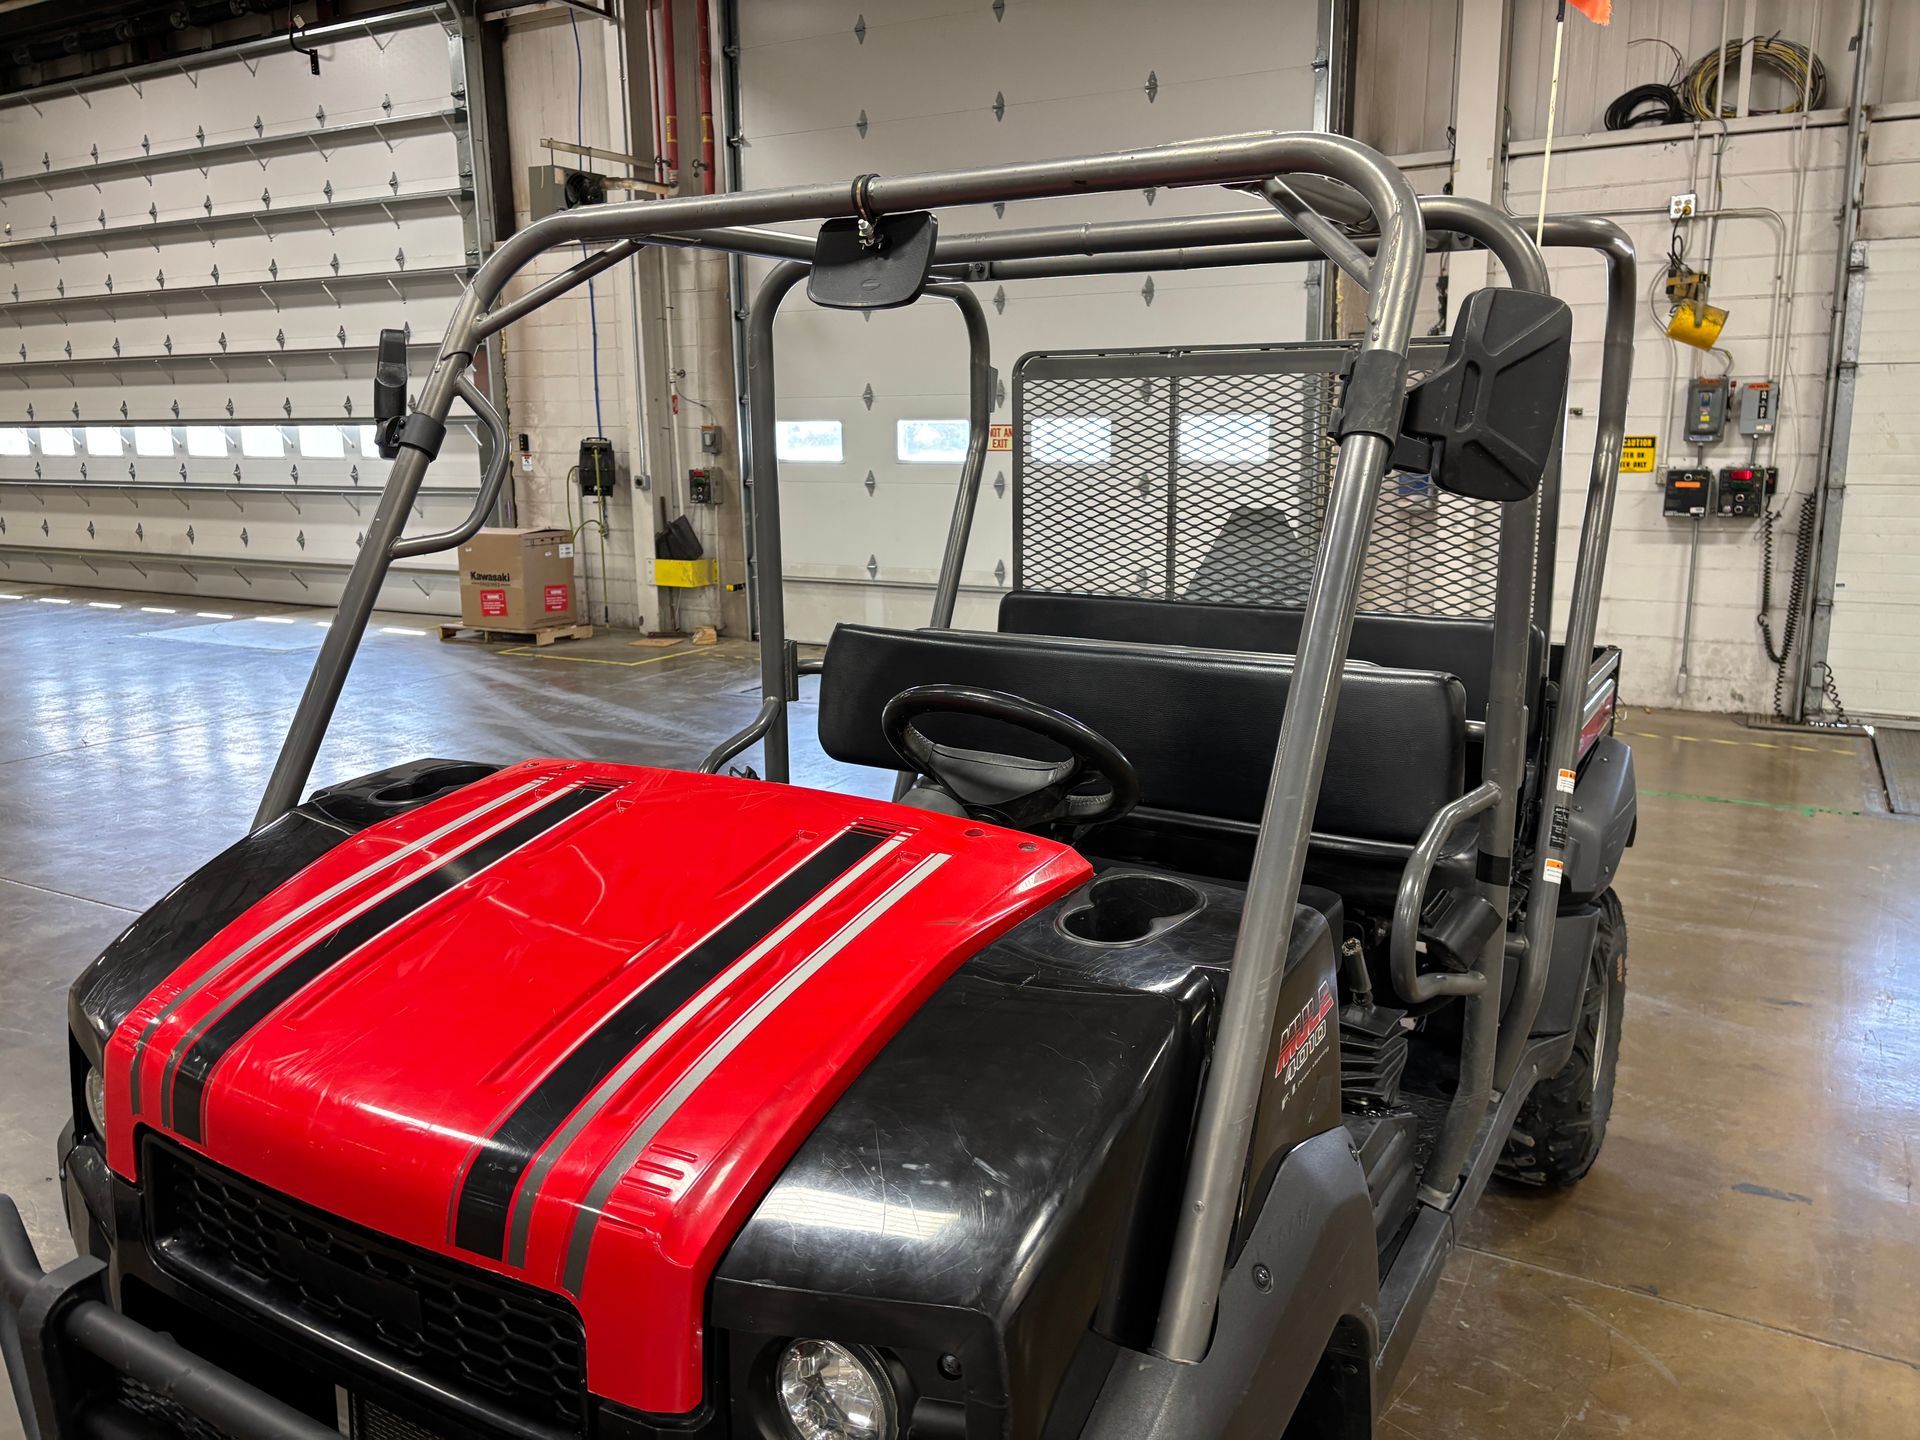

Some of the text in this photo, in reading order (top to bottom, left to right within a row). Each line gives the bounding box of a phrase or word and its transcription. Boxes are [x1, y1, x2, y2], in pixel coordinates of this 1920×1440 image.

[991, 428, 1001, 437] OT
[992, 439, 1008, 448] EXIT
[470, 571, 510, 582] Kawasaki
[1274, 980, 1334, 1079] MULE
[1285, 1019, 1327, 1085] 4010
